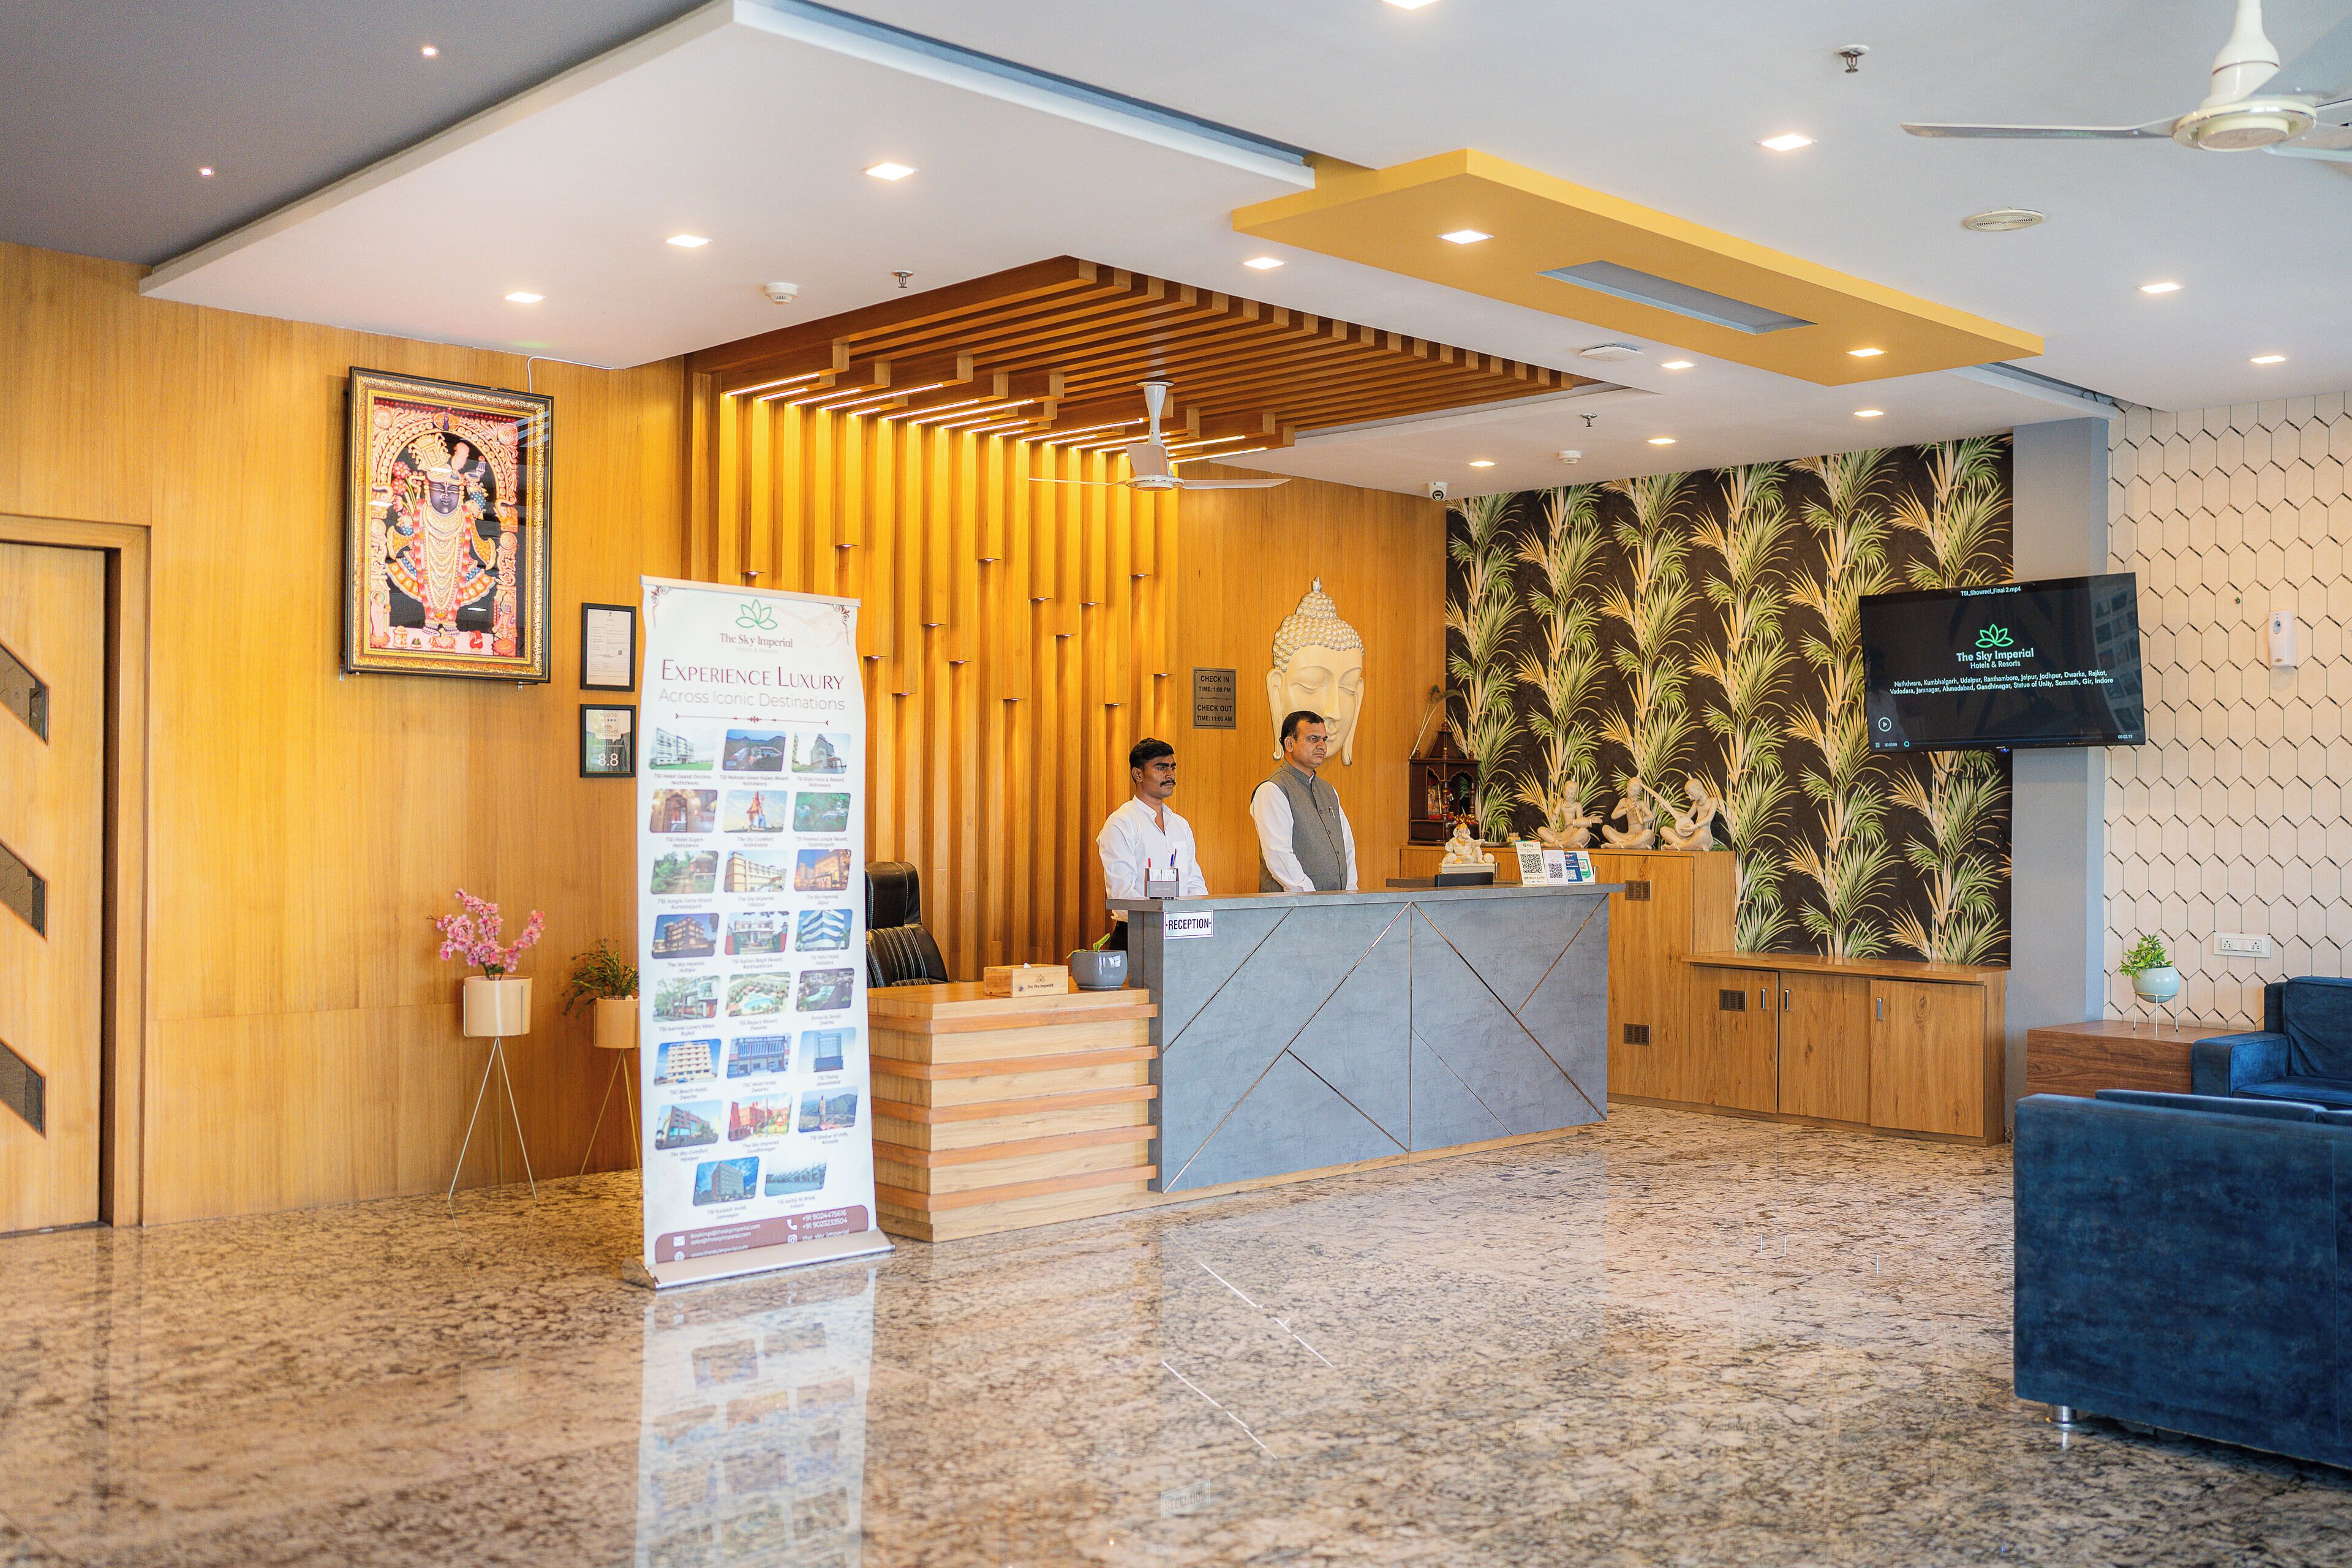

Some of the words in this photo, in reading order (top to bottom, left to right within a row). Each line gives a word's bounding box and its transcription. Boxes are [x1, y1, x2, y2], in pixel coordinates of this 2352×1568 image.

[720, 633, 736, 643] The
[738, 635, 755, 647] Sky
[758, 636, 793, 648] Imperial
[1956, 652, 1973, 662] The
[1976, 650, 1992, 662] Sky
[1994, 647, 2034, 661] Imperial
[662, 659, 772, 685] EXPERIENCE
[778, 666, 844, 690] LUXURY
[1924, 677, 1959, 686] Kumbhalgarh,
[1977, 681, 2012, 690] Gandhinagar,
[658, 688, 709, 704] Across
[713, 690, 755, 706] Iconic
[760, 693, 845, 710] Destinations
[598, 753, 619, 766] 8.8
[1169, 918, 1209, 930] RECEPTION
